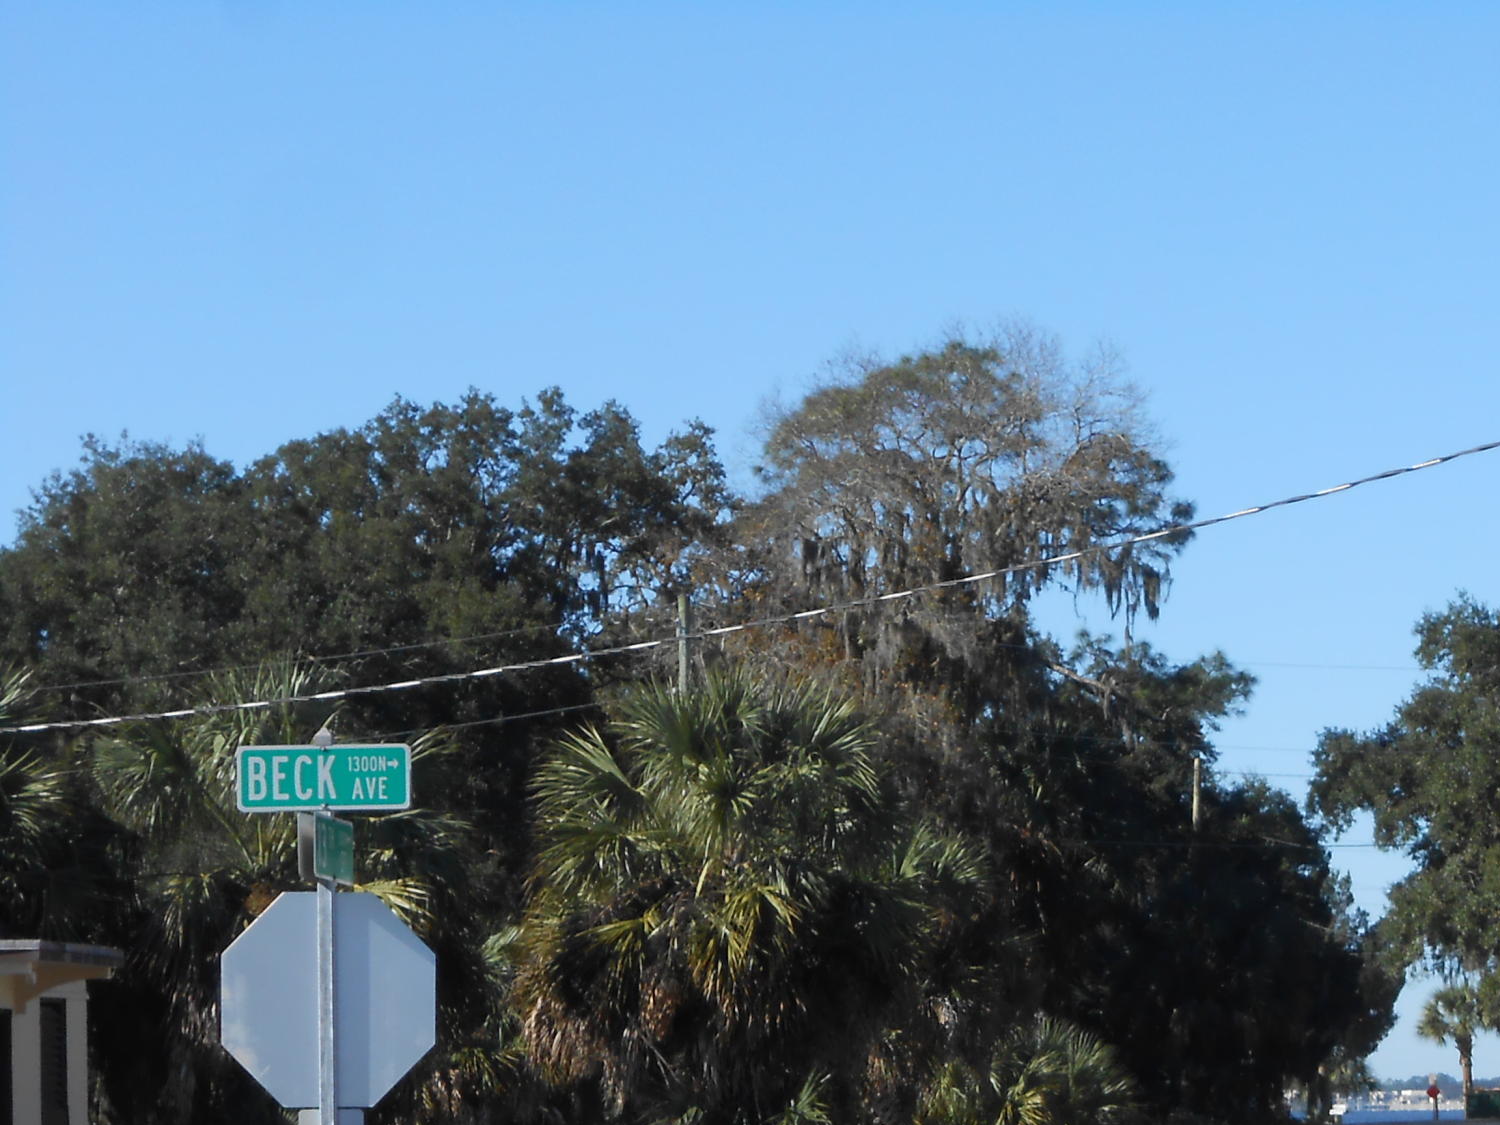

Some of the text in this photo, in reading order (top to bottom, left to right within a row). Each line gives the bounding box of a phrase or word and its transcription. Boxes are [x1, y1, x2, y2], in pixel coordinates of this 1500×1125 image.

[348, 756, 386, 772] 1300N
[248, 755, 337, 801] BECK
[352, 777, 388, 800] AVE
